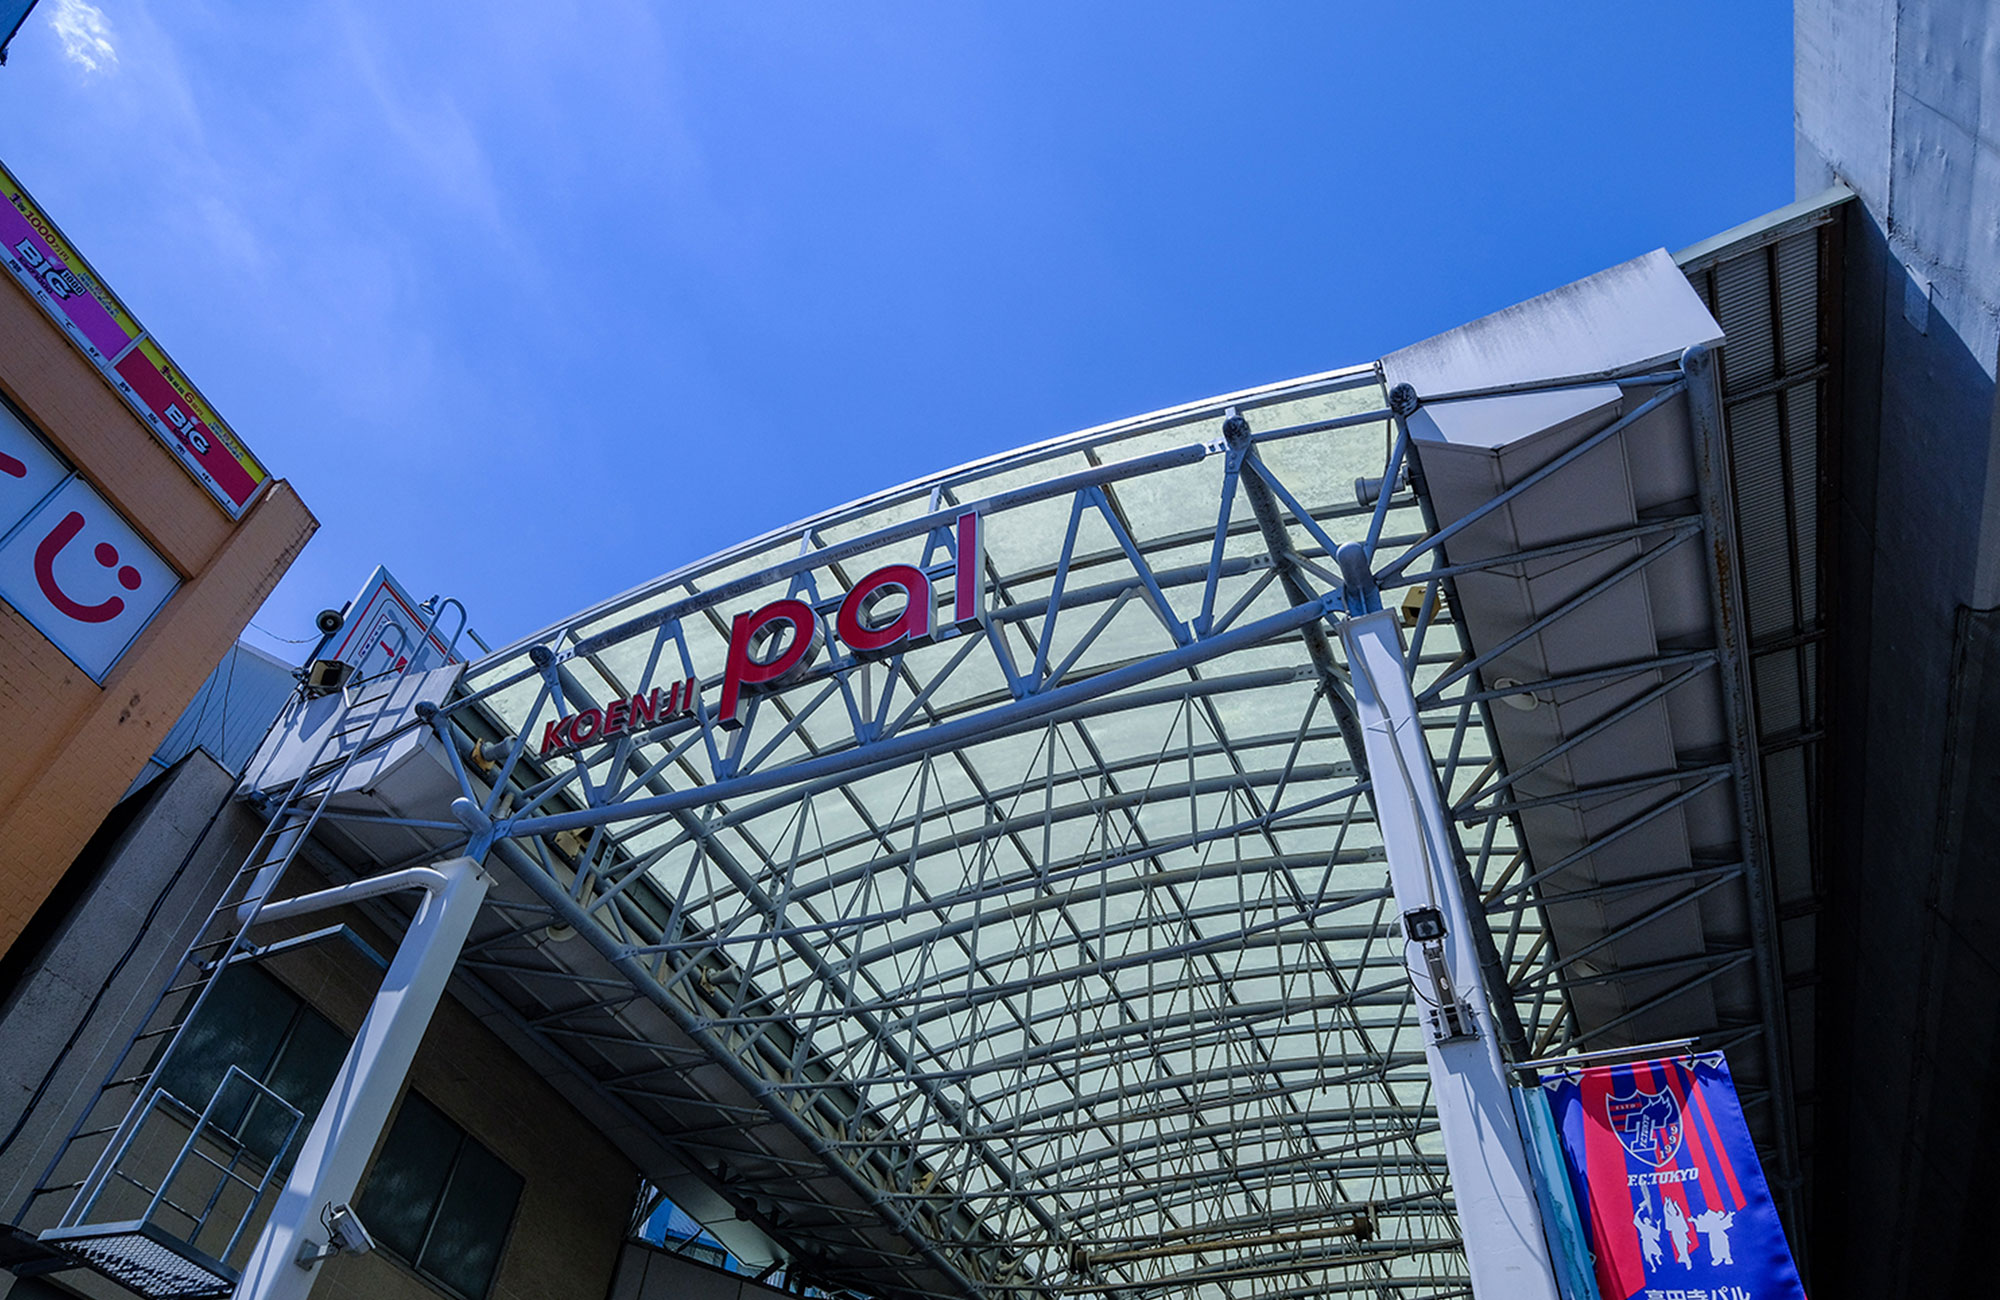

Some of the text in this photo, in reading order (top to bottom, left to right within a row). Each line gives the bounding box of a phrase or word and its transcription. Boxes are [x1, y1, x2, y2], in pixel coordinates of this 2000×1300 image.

[62, 270, 84, 294] 1000
[163, 402, 212, 456] BIG
[540, 511, 984, 756] KOENJI pal
